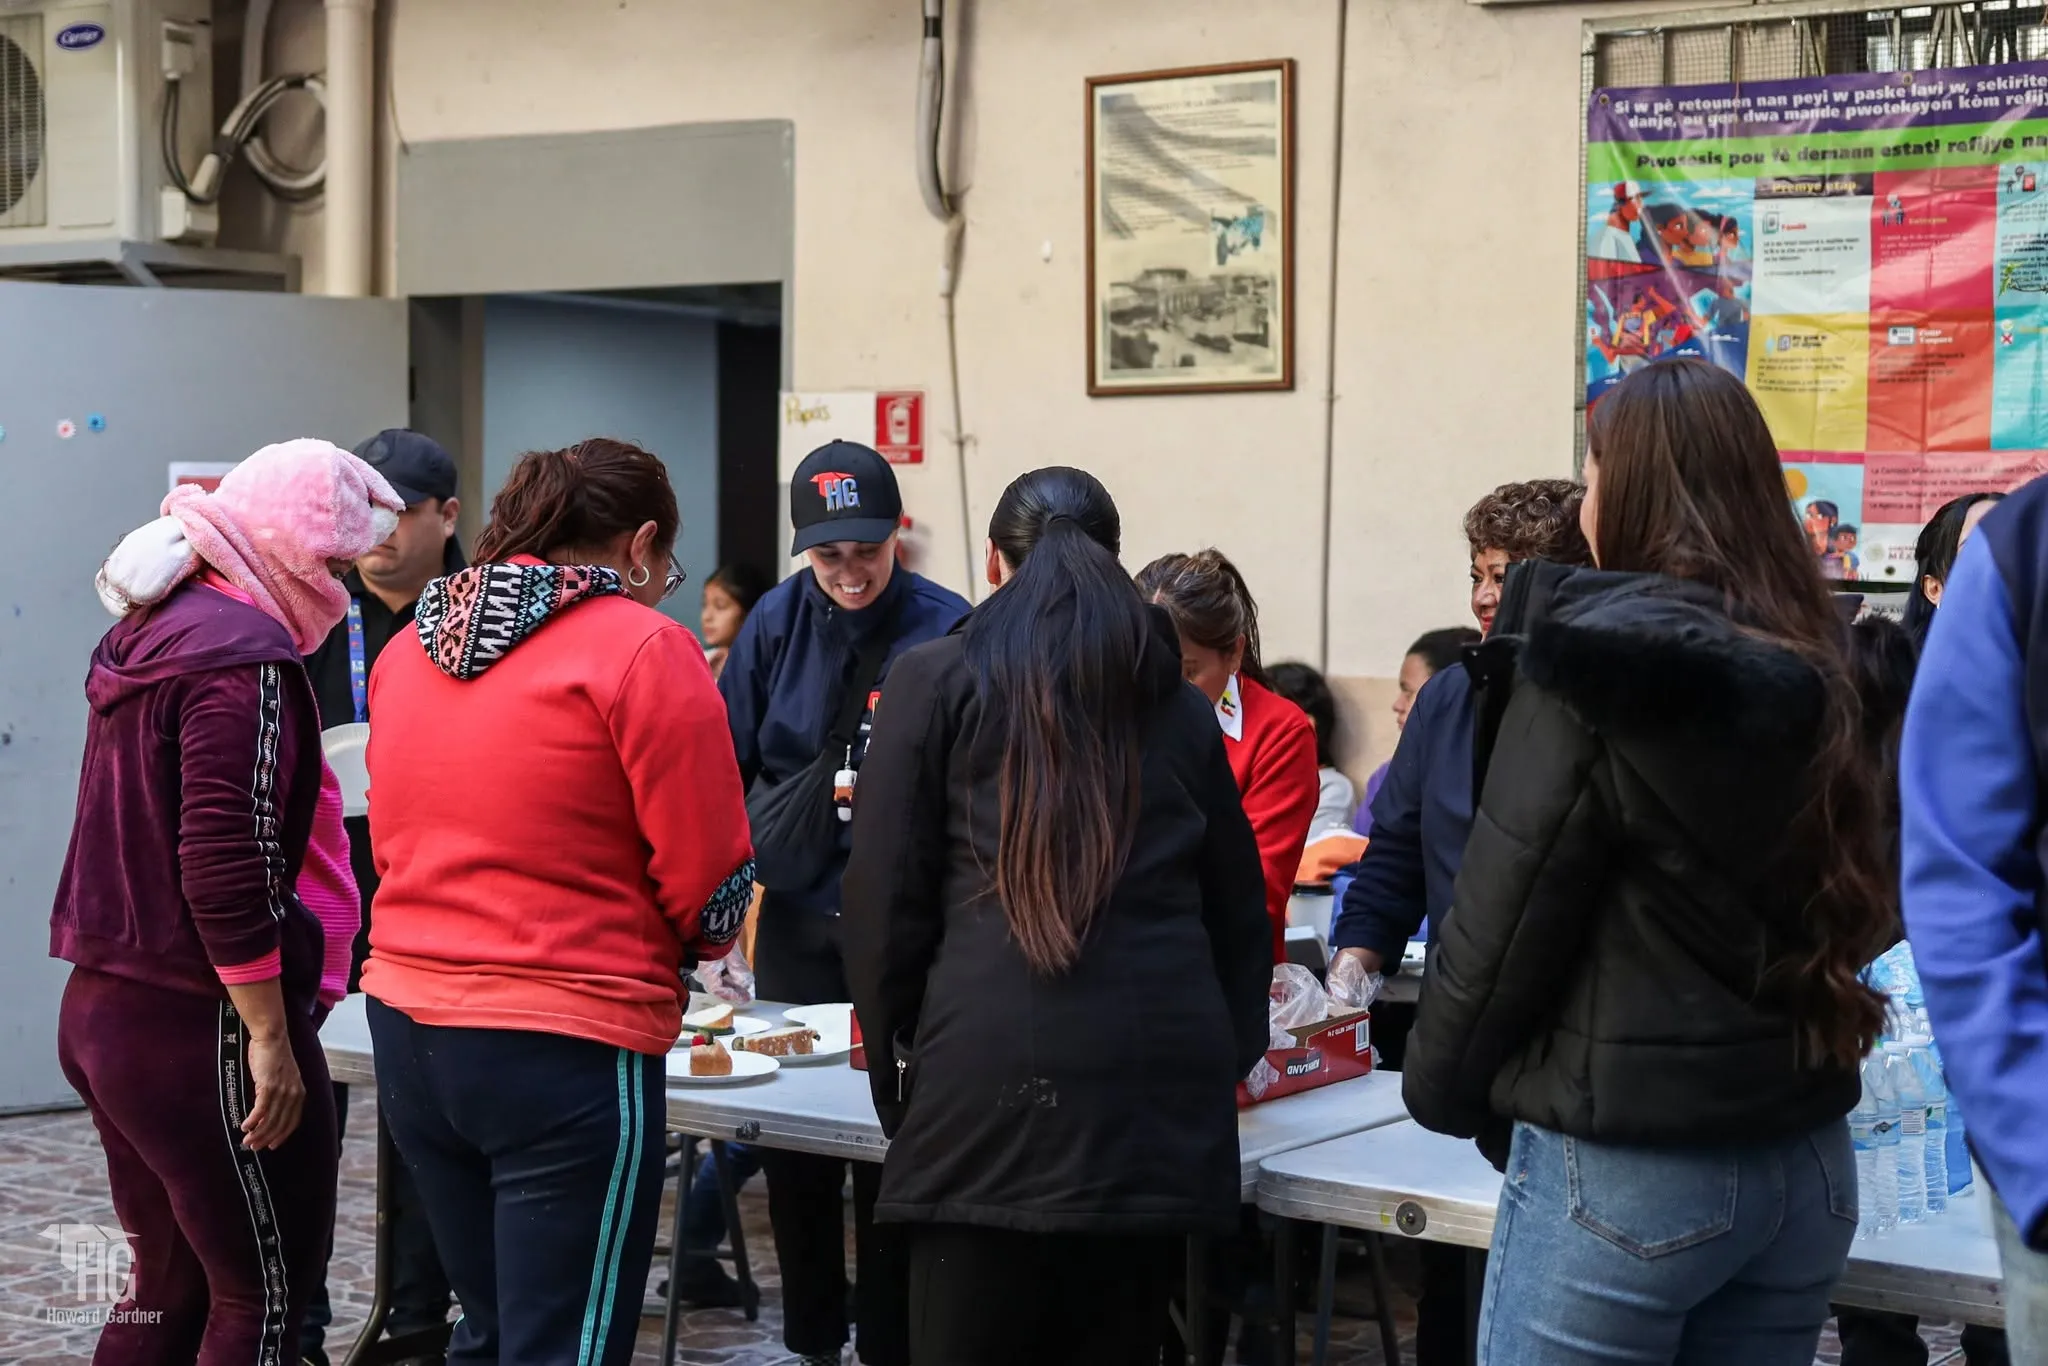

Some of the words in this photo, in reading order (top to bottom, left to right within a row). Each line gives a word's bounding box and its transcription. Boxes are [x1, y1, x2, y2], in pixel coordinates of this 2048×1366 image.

[1614, 100, 1629, 114] Si
[1634, 102, 1649, 114] w
[1678, 96, 1752, 112] retounen
[1756, 95, 1787, 107] nan
[1792, 88, 1828, 108] peyi
[1832, 91, 1848, 102] w
[1854, 85, 1906, 104] paske
[1911, 80, 1944, 97] lavi
[1976, 74, 2048, 93] sekirite
[1743, 109, 1780, 123] dwa
[1784, 105, 1841, 121] mande
[1845, 97, 1952, 120] pwoteksyon
[1728, 152, 1764, 168] pou
[1797, 146, 1874, 161] demann
[1948, 135, 2014, 154] refijye
[824, 478, 861, 512] HG
